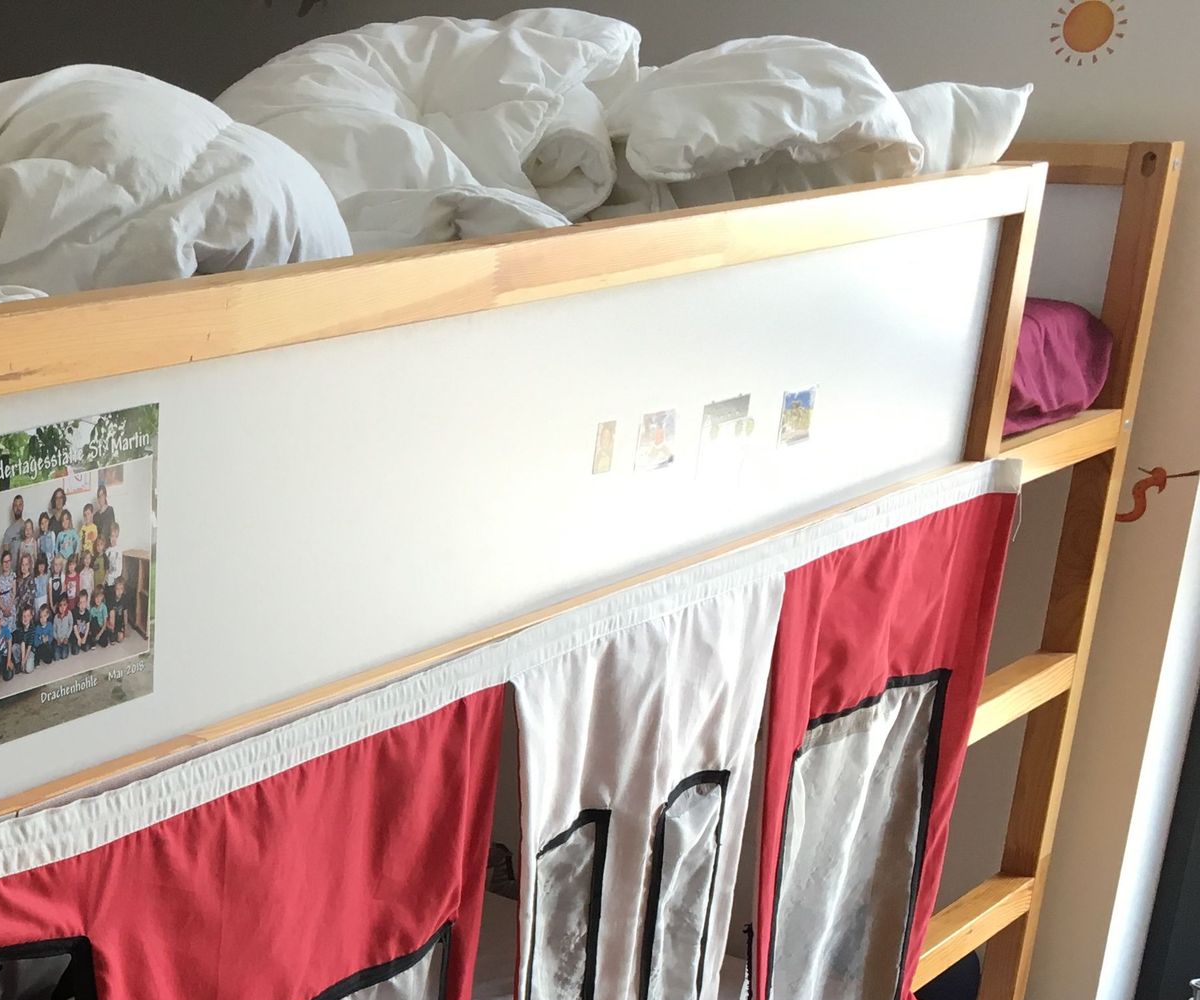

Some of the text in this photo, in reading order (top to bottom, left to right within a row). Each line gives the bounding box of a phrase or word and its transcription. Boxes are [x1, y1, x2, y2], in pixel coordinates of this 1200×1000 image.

[111, 432, 150, 455] Martin
[40, 661, 145, 703] Drachenhöhle Mai 2018
